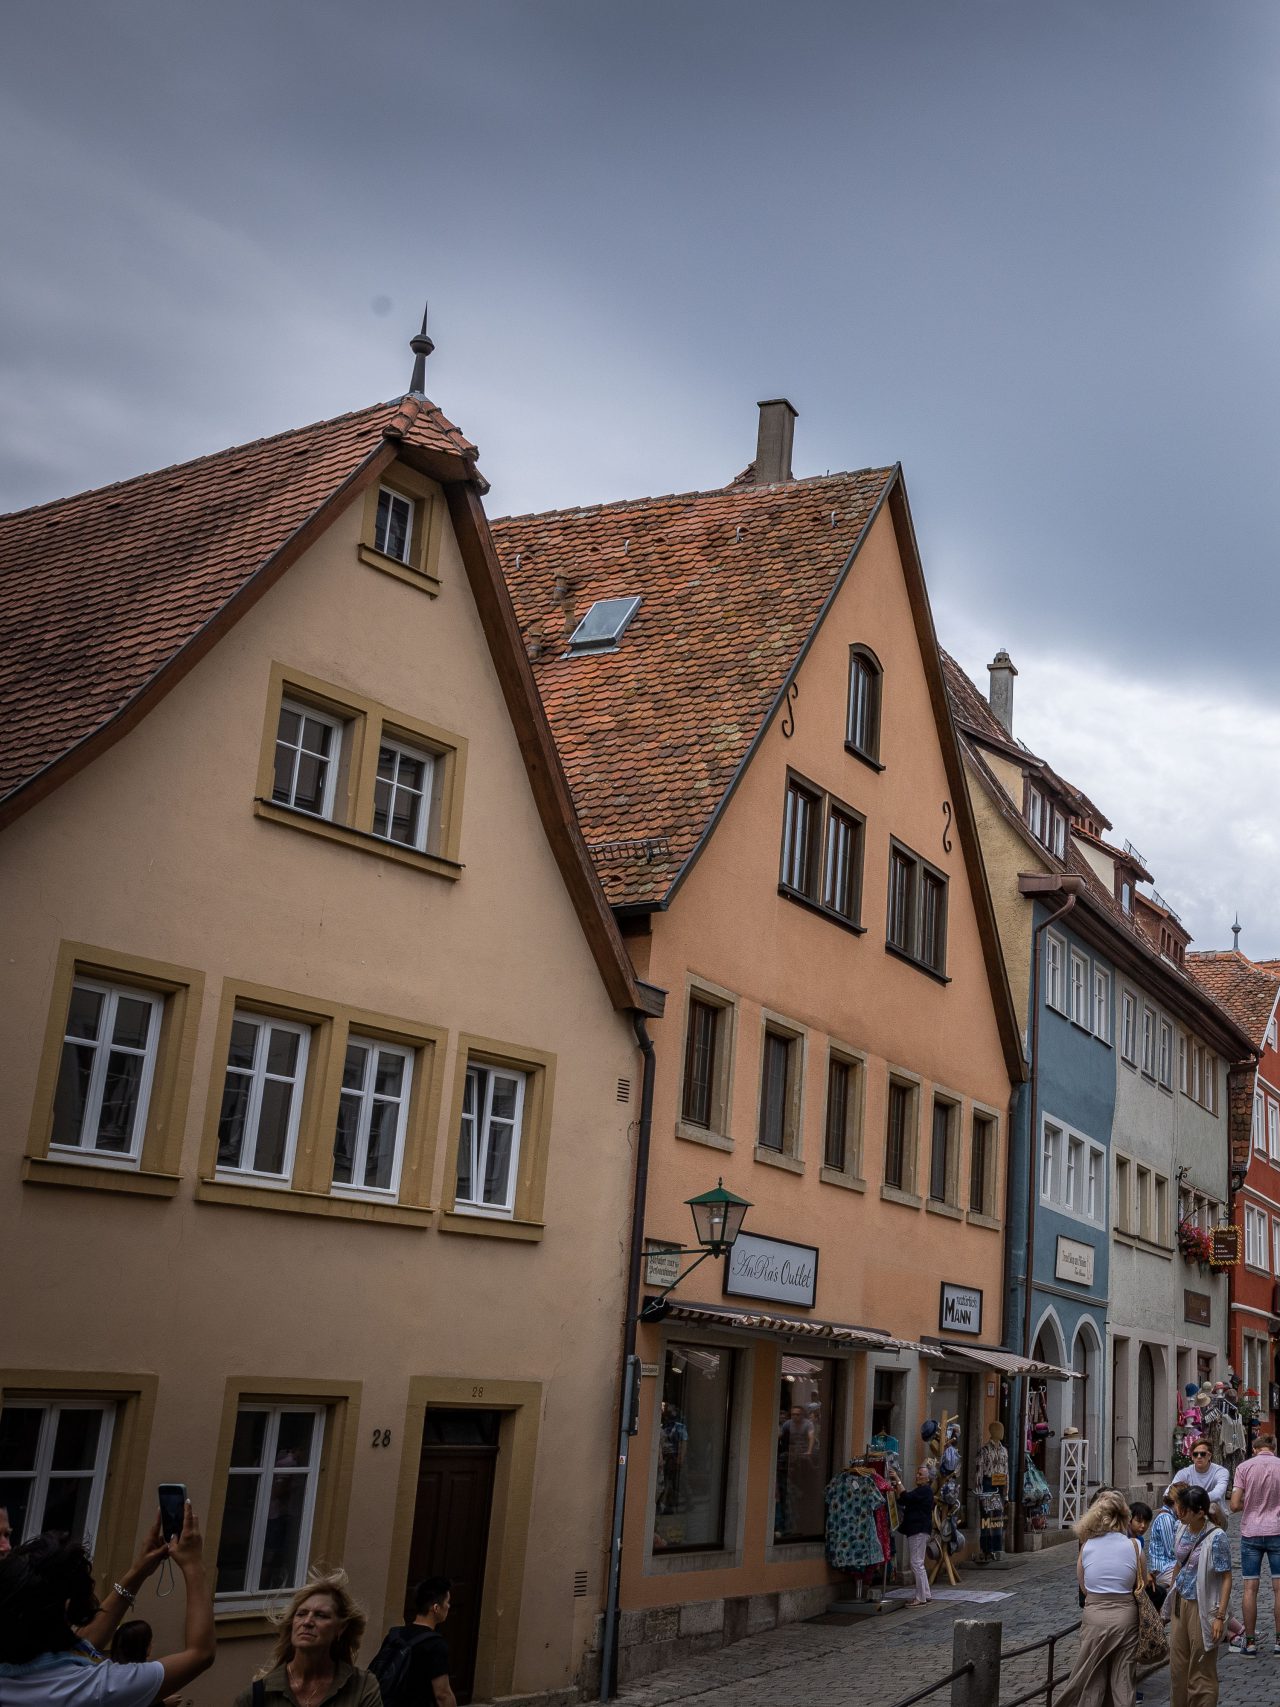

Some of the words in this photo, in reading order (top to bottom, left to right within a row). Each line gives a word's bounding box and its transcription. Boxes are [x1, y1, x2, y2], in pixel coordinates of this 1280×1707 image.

[780, 1259, 812, 1289] Outlet
[944, 1296, 972, 1326] MANN
[472, 1386, 484, 1398] 28
[372, 1428, 392, 1448] 28
[981, 1517, 1004, 1529] MANN
